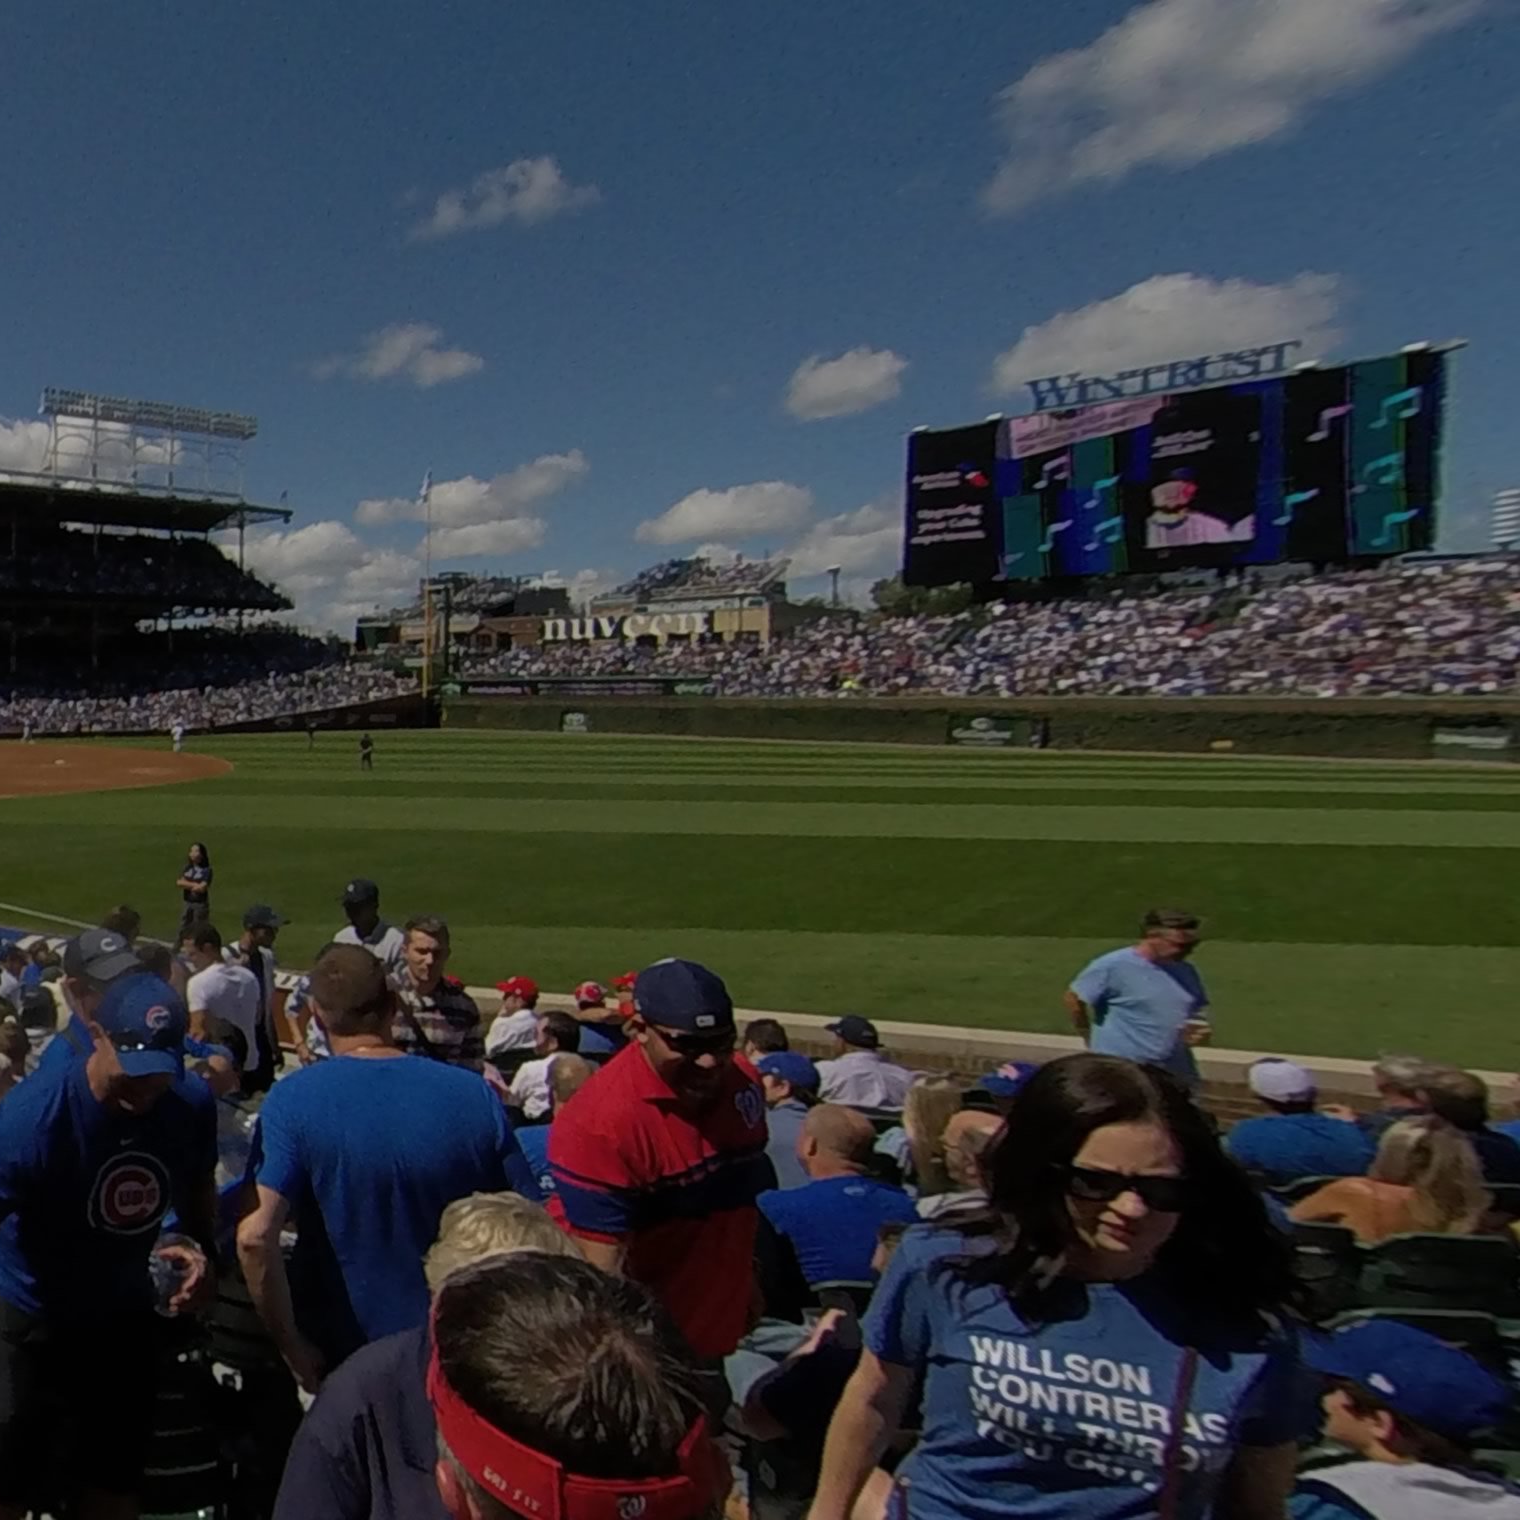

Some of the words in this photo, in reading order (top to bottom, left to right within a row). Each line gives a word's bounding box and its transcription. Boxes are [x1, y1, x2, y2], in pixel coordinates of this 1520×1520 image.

[543, 612, 709, 641] nuveen
[968, 1334, 1153, 1396] WILLSON
[971, 1365, 1230, 1444] CONTRERAS
[1074, 1421, 1235, 1474] THRO
